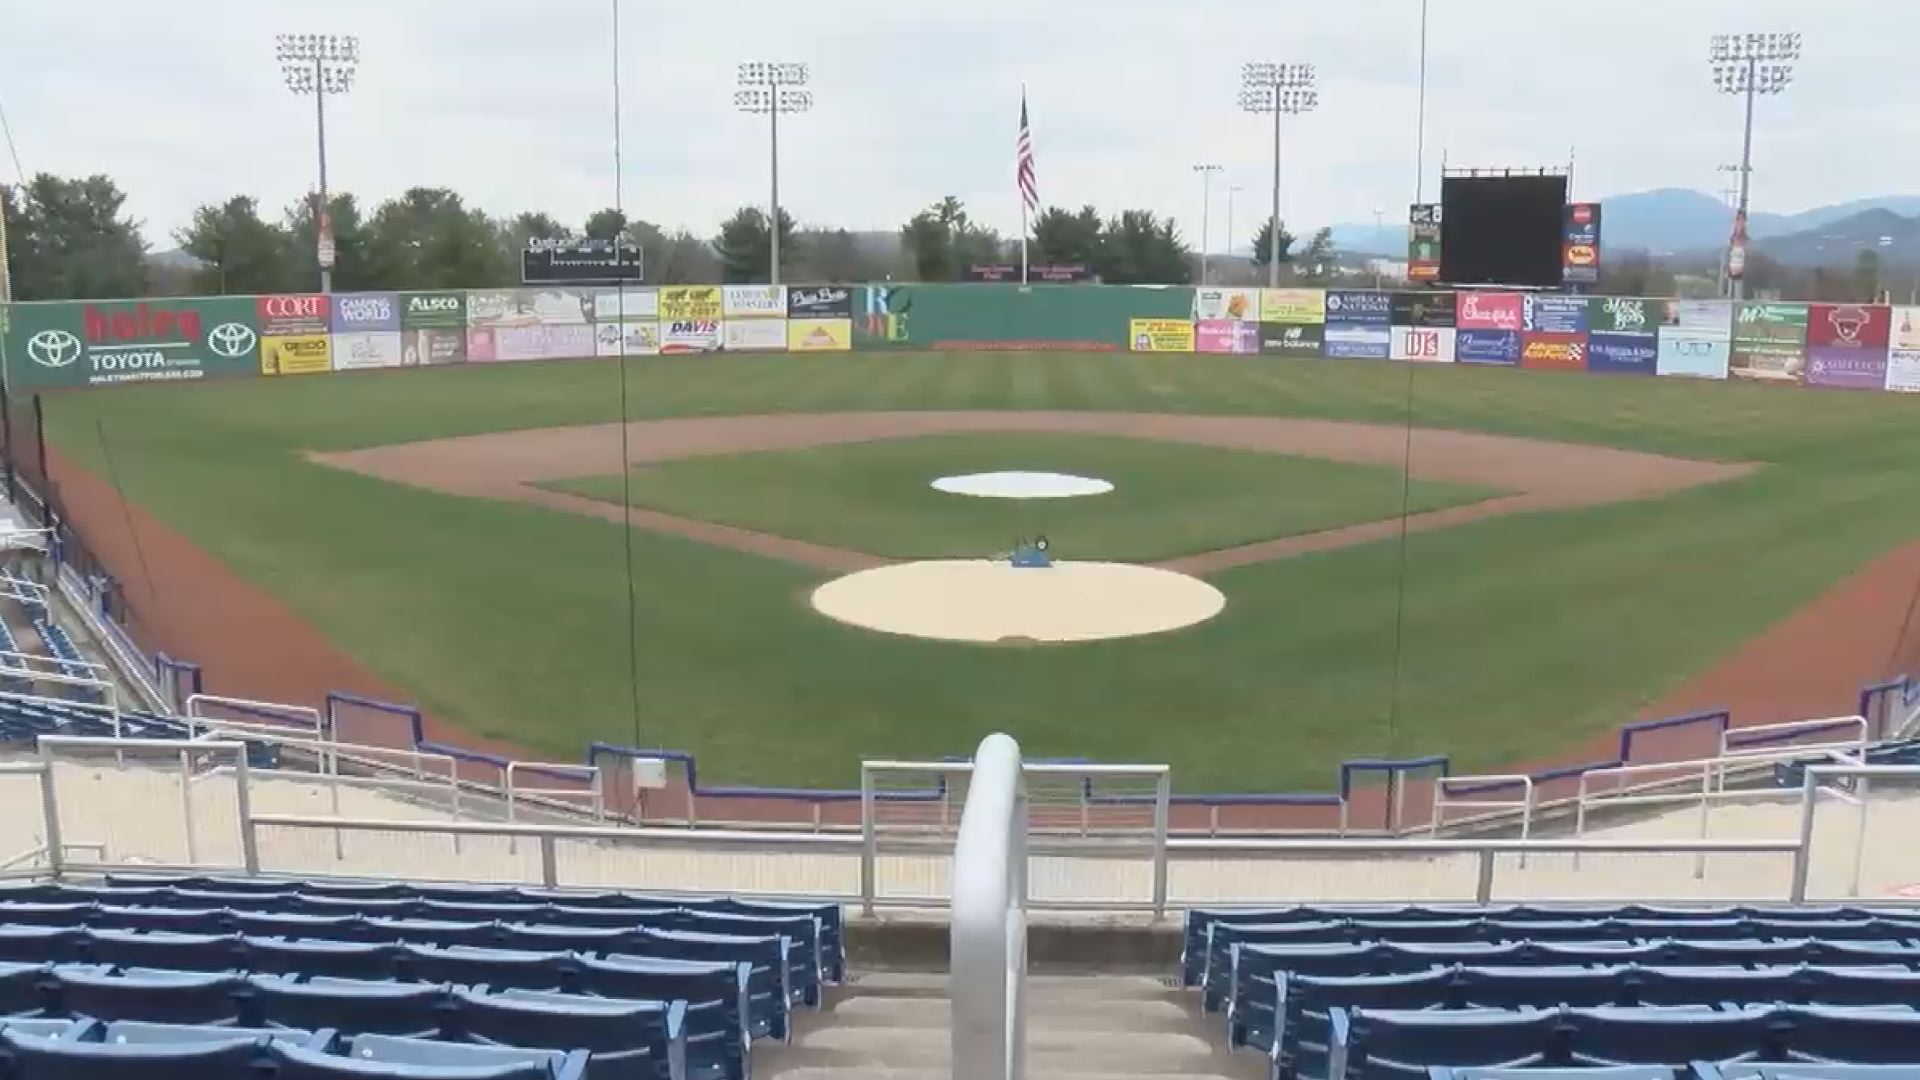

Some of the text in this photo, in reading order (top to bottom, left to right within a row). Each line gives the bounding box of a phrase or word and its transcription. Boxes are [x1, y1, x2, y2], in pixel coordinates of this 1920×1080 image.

[266, 297, 320, 316] CORT
[340, 297, 391, 311] CAMPING
[1342, 295, 1390, 304] AMERICAN
[342, 306, 392, 321] WORLD
[1341, 303, 1389, 312] NATIONAL
[85, 303, 200, 342] haley
[671, 320, 720, 334] DAVIS
[284, 341, 327, 352] GEICO
[1283, 338, 1320, 350] balance
[89, 351, 167, 371] TOYOTA
